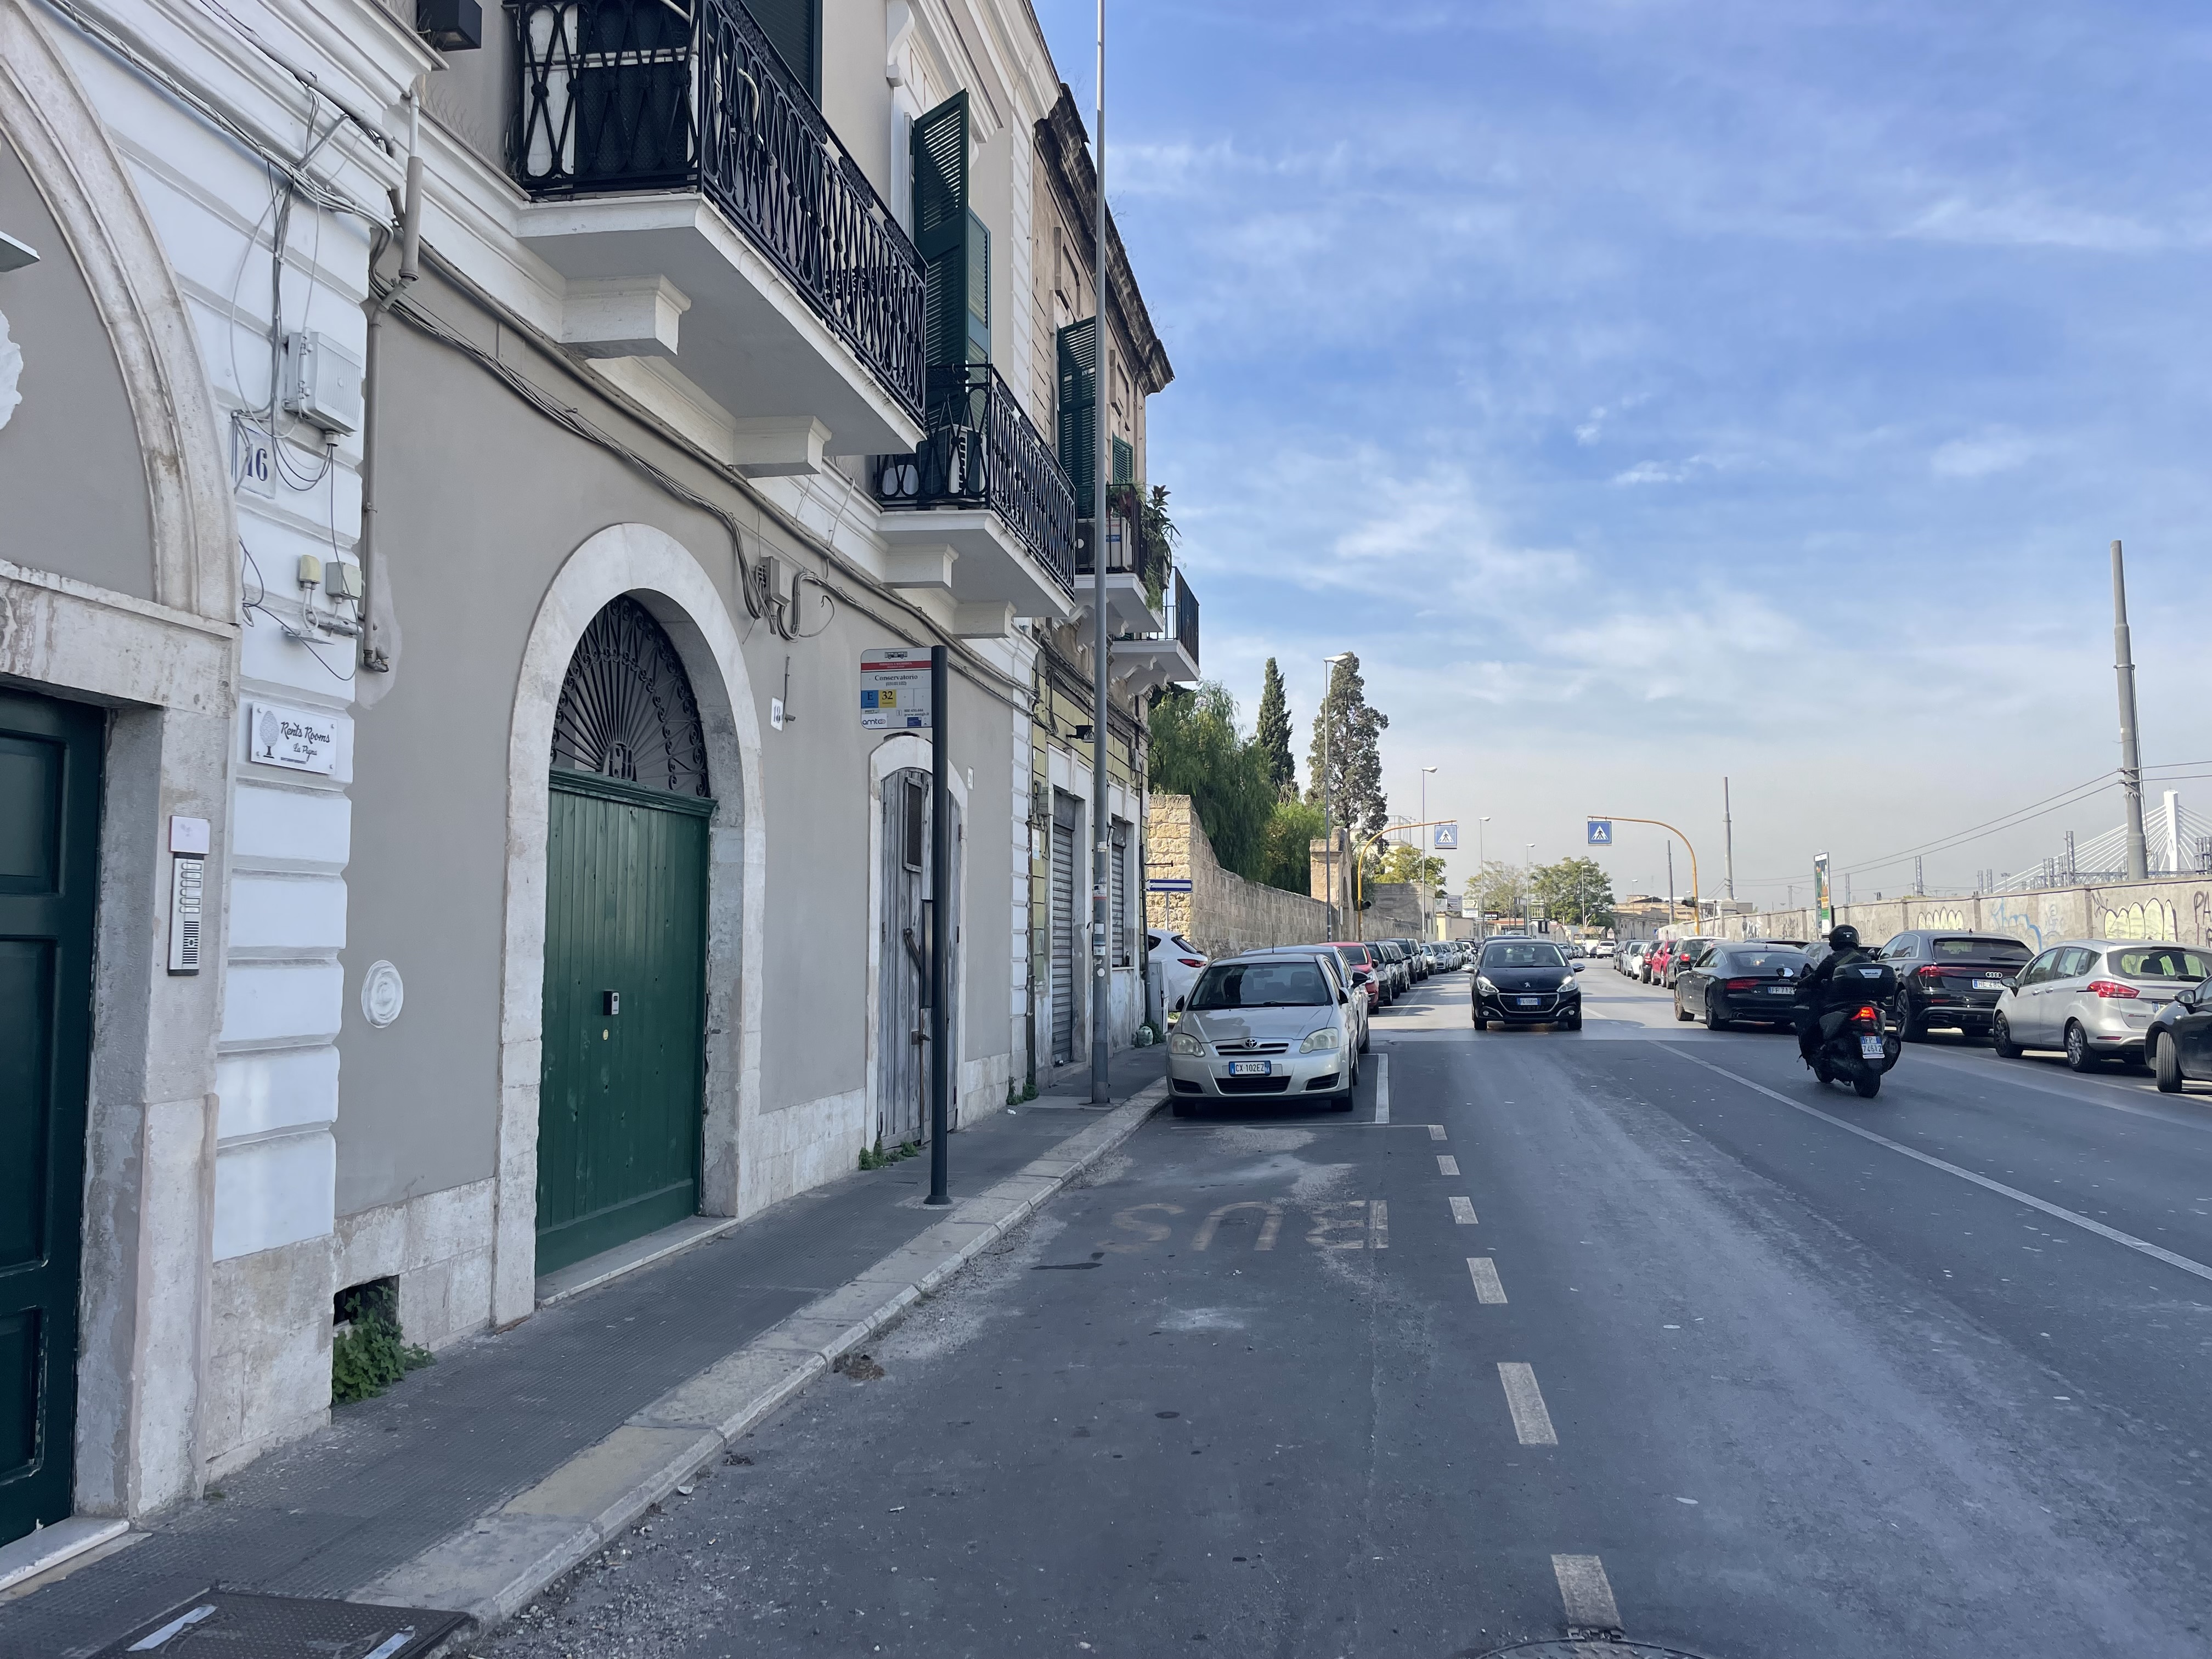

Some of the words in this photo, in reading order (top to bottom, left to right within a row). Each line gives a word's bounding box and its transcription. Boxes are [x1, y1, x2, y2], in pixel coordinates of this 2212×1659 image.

[867, 691, 873, 701] E
[882, 691, 893, 700] 32
[773, 706, 781, 724] 18
[304, 726, 330, 744] Rooms
[302, 745, 317, 761] Pigna
